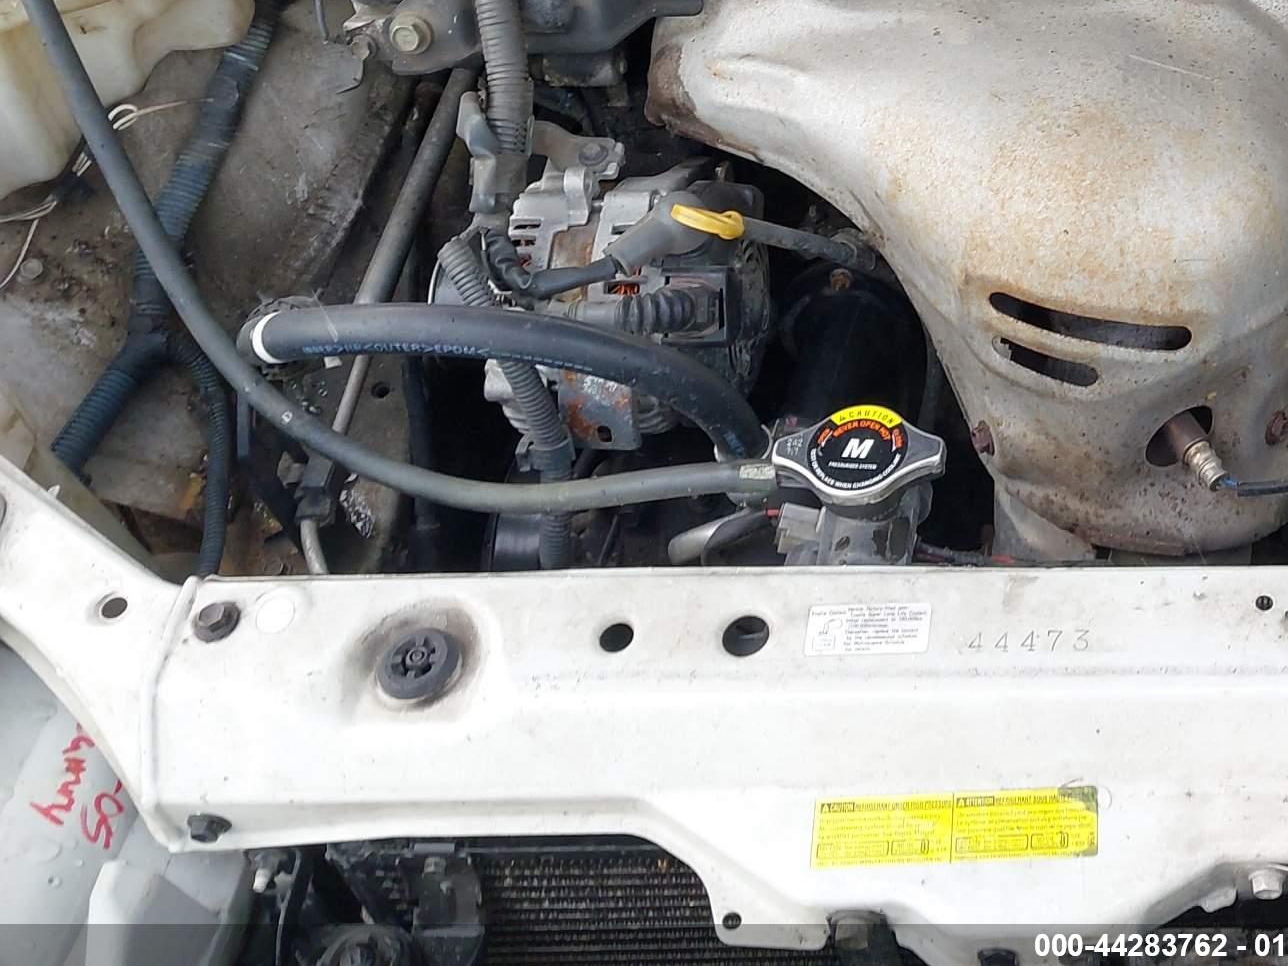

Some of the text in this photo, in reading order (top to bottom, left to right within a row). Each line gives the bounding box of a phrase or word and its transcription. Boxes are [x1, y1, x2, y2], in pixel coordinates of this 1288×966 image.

[848, 410, 895, 424] CAUTION
[859, 420, 881, 432] OPEN
[841, 437, 875, 459] M
[834, 480, 852, 489] WHEN
[967, 629, 1091, 653] 44473
